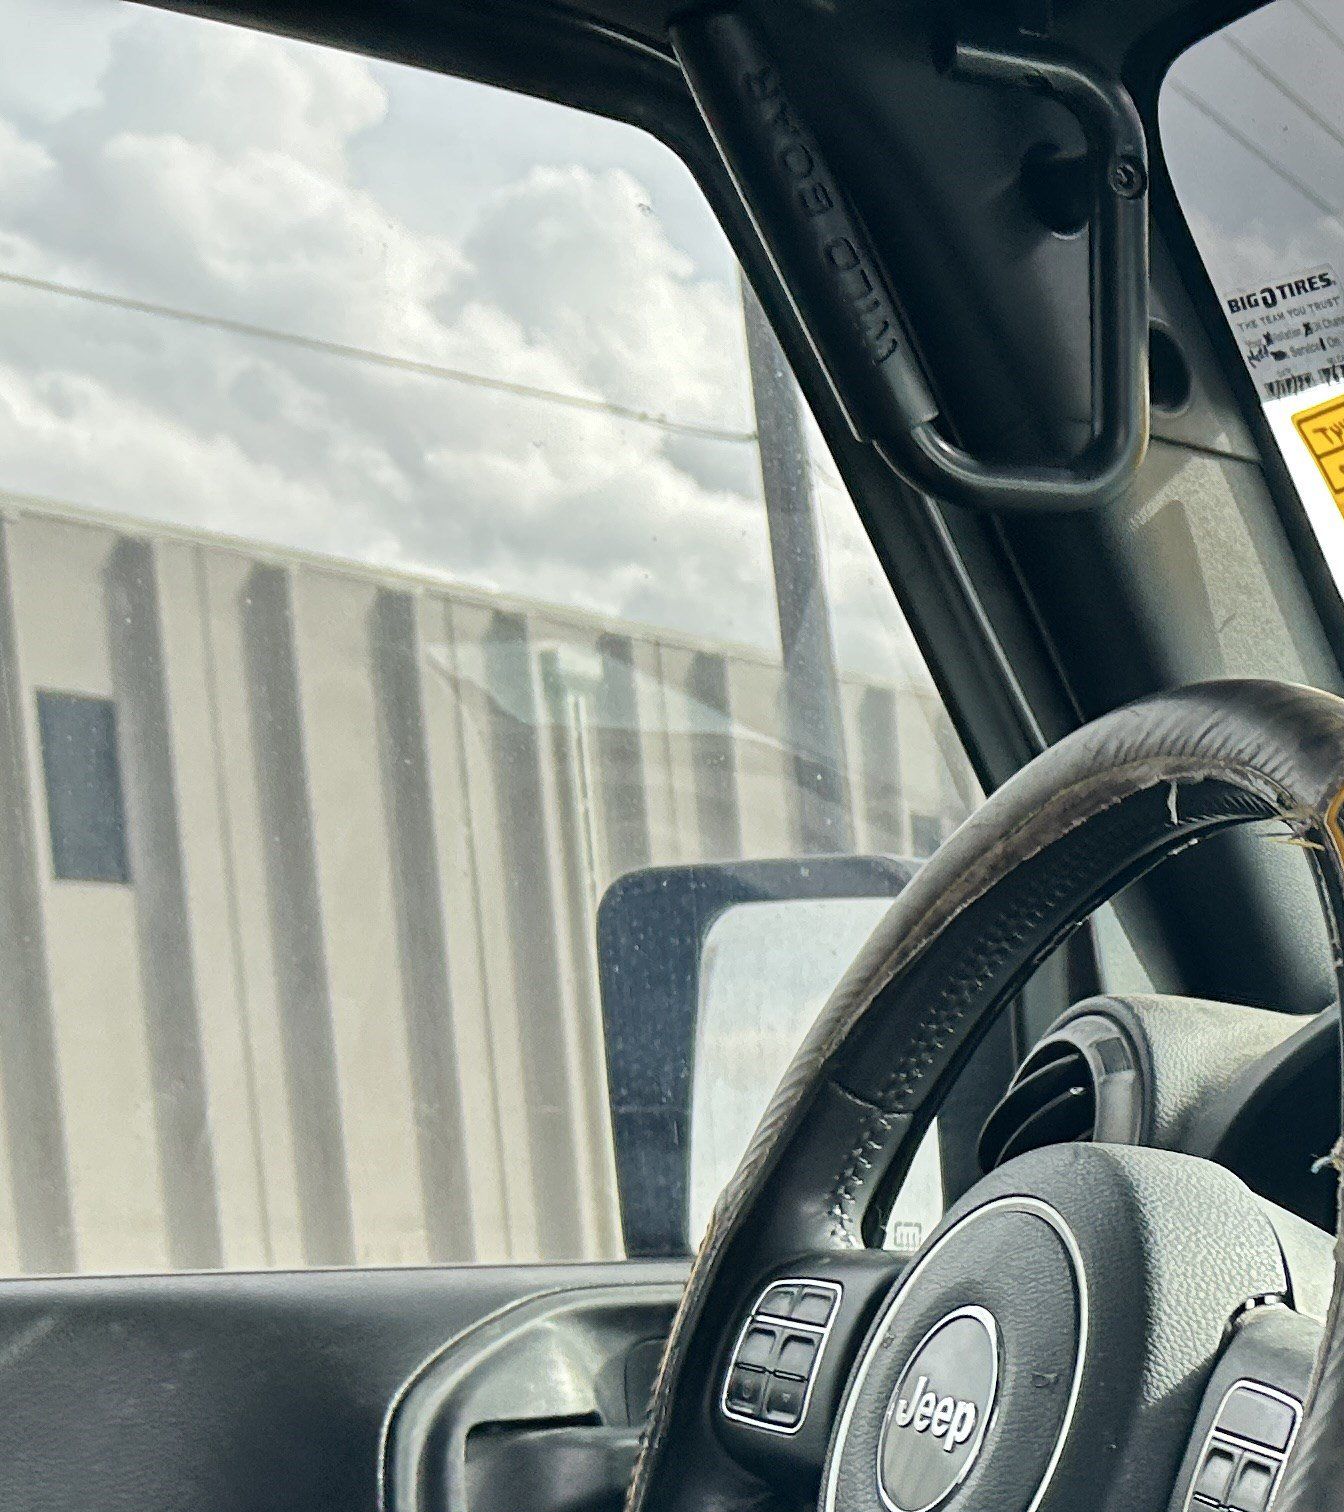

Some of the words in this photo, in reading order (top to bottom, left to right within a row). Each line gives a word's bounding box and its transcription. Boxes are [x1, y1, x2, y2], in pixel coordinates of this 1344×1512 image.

[1227, 291, 1260, 314] BIG
[1276, 272, 1333, 300] TIRES
[1259, 311, 1286, 325] TEAM
[1287, 306, 1307, 319] YOU
[1308, 296, 1341, 313] TRUST
[894, 1375, 979, 1453] Jeep
